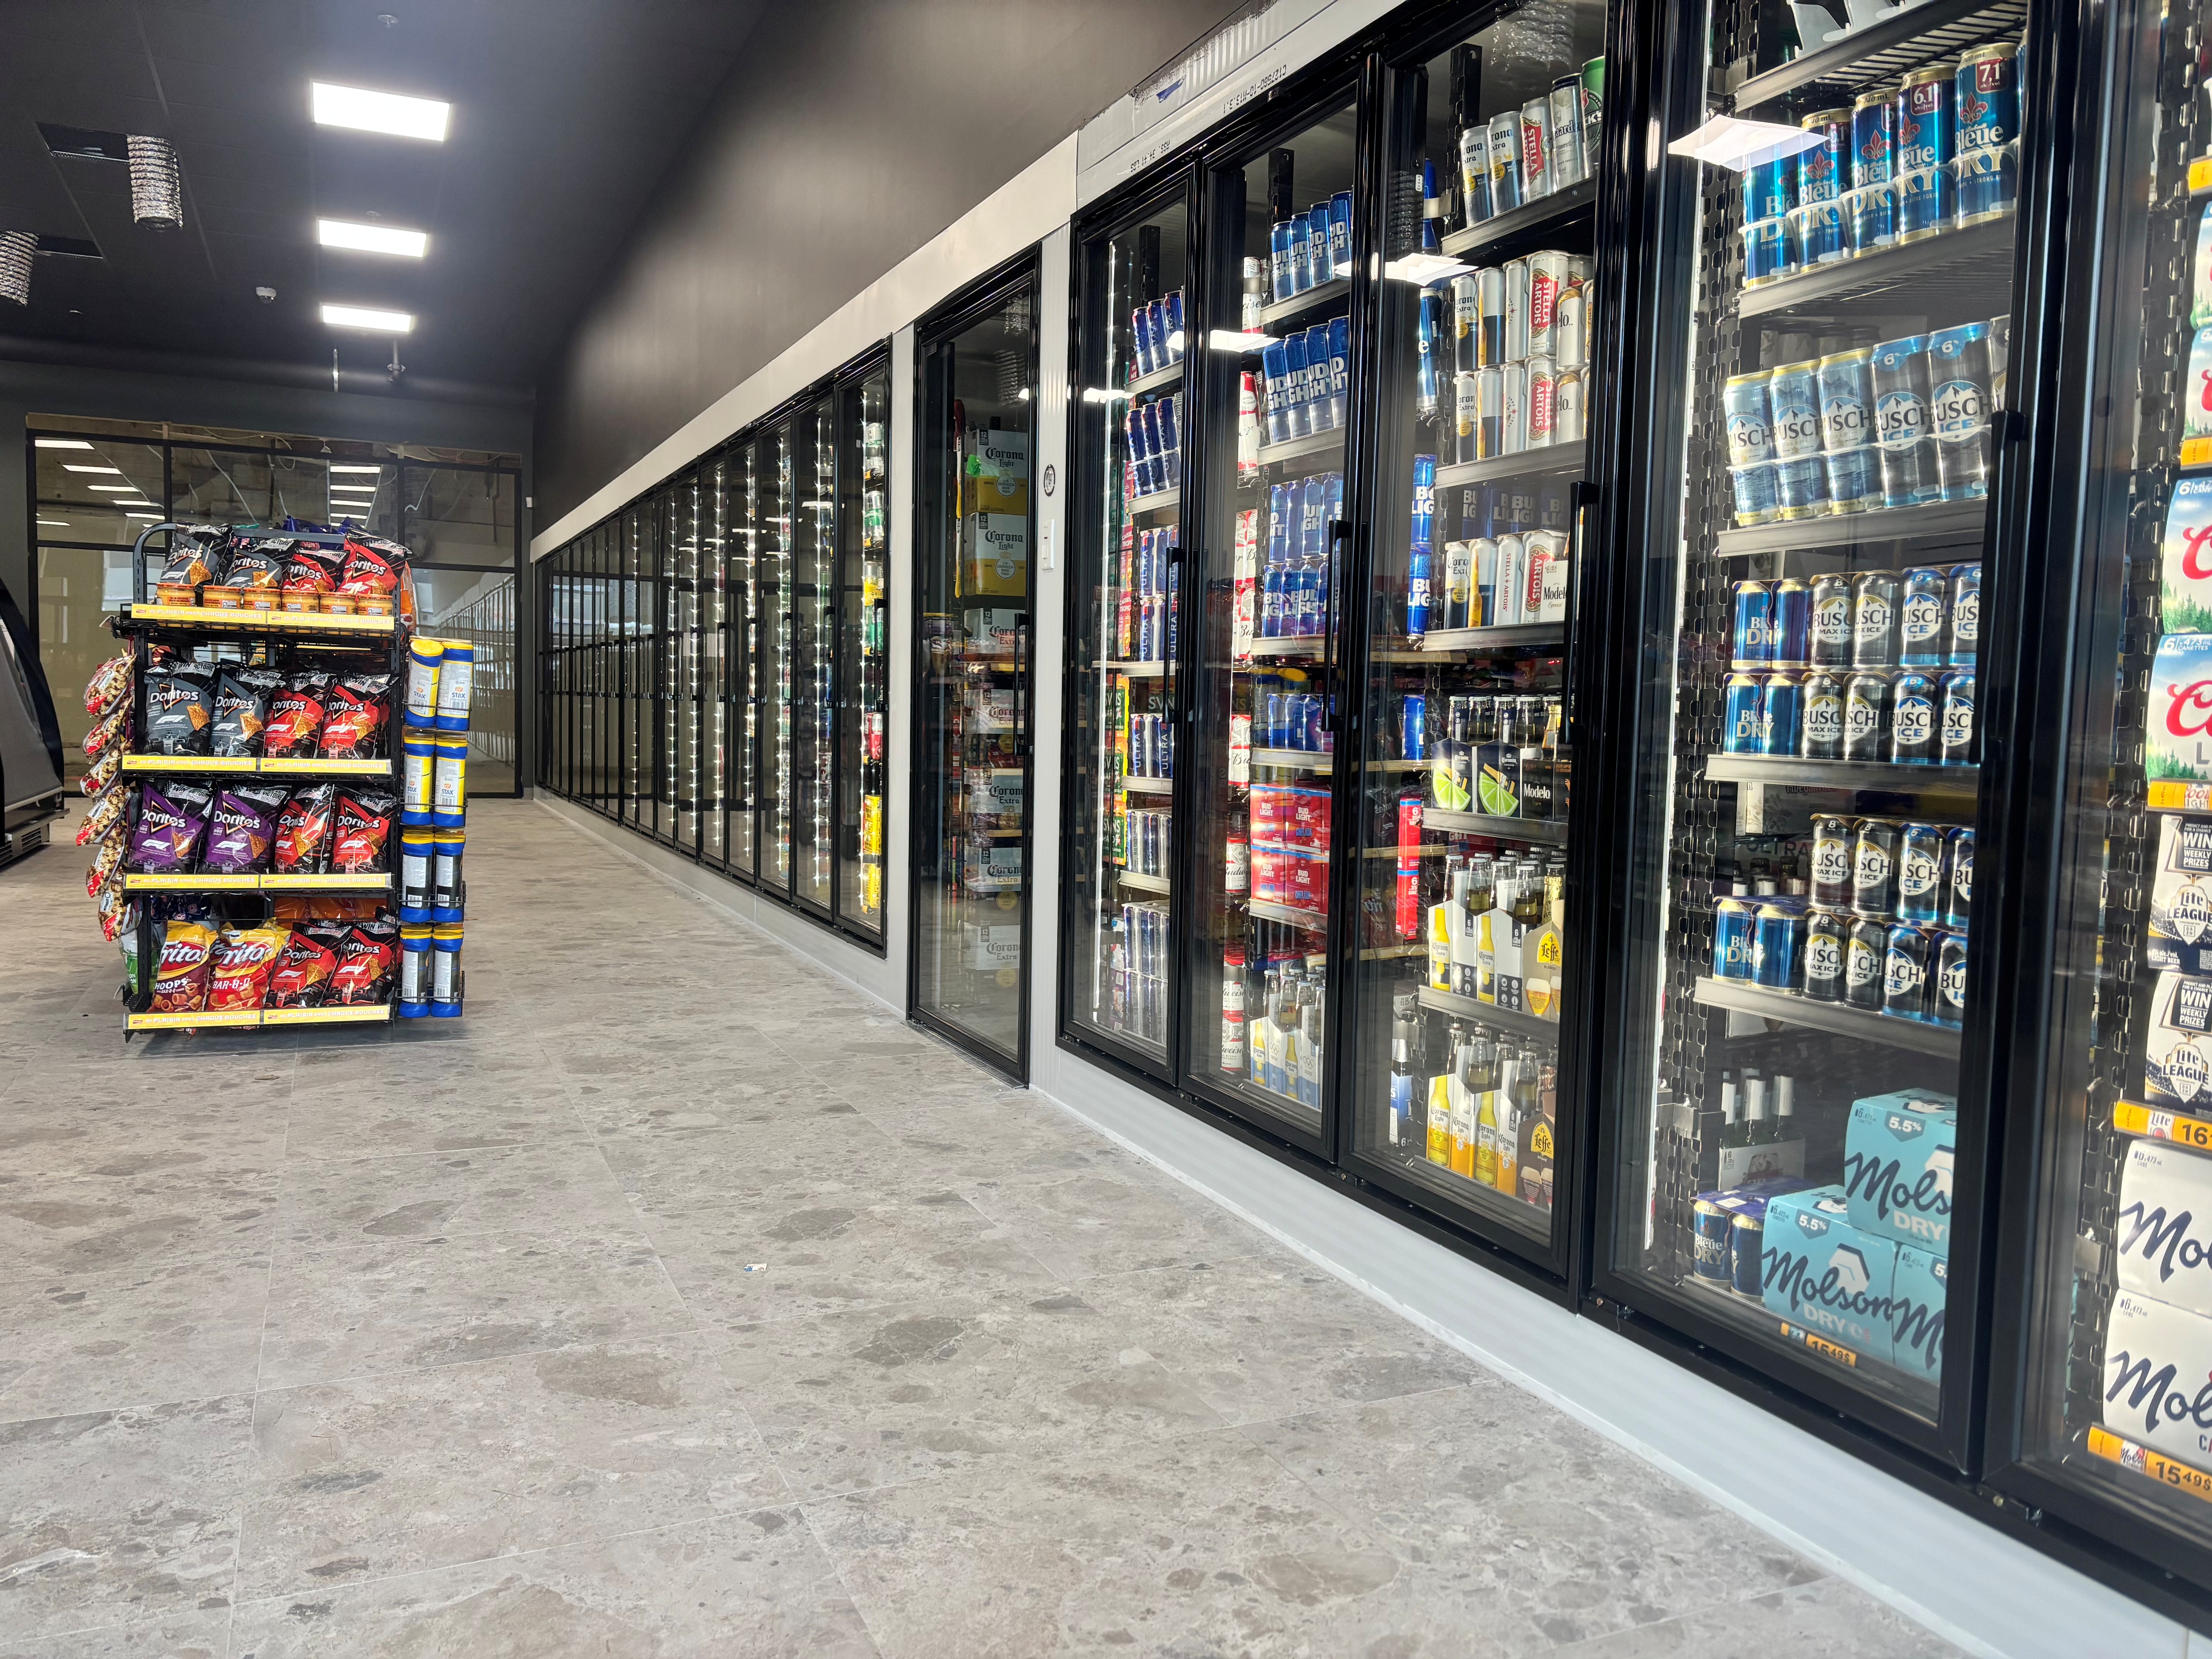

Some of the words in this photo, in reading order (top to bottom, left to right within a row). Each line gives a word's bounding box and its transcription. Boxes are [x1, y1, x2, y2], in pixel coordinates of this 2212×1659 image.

[1528, 128, 1537, 172] STELLA
[1932, 395, 1990, 423] USCH
[1823, 408, 1873, 434] USCH
[1940, 418, 1974, 433] ICE
[1729, 426, 1772, 450] USCH
[1884, 428, 1915, 442] ICE
[986, 447, 1025, 461] Corona
[999, 459, 1014, 467] Light
[985, 531, 1023, 544] Corona
[998, 542, 1013, 550] Light
[1533, 558, 1543, 599] ARTOIS
[1544, 586, 1566, 600] Model
[1856, 609, 1895, 626] USCH
[150, 689, 199, 703] Doritos
[215, 696, 254, 709] Doritos
[273, 700, 306, 711] oritos
[1898, 728, 1924, 737] ICE
[989, 785, 1023, 799] Coron
[1524, 783, 1551, 799] Modelo
[214, 811, 260, 829] Doritos
[1296, 814, 1311, 822] LIGHT
[2183, 832, 2212, 849] WIN
[2183, 857, 2209, 867] PRIZES
[2184, 850, 2211, 859] WEEKLY
[987, 864, 1022, 877] Coron
[1296, 875, 1310, 884] LIGHT
[2180, 891, 2203, 907] Lite
[347, 942, 381, 953] oritos
[986, 942, 1020, 955] Coron
[1541, 943, 1559, 961] Leffe
[155, 977, 188, 990] HOOPS
[2181, 989, 2211, 1008] WIN
[2179, 1015, 2205, 1026] PRIZES
[2180, 1008, 2208, 1018] WEEKLY
[2176, 1050, 2199, 1066] Lite
[2162, 1064, 2209, 1085] LEAGUE
[1431, 1106, 1449, 1118] Corona
[2151, 1111, 2170, 1126] Lite
[1453, 1116, 1469, 1131] Corona
[1477, 1123, 1496, 1136] Corona
[1889, 1116, 1922, 1132] 5.5%
[1499, 1133, 1515, 1149] Corona
[1535, 1134, 1551, 1153] Leffe
[1845, 1152, 1952, 1221] Mols
[1799, 1214, 1826, 1230] 5.5%
[1894, 1210, 1944, 1240] DRY
[1695, 1233, 1723, 1250] Bleue
[1694, 1245, 1725, 1265] DRY
[1762, 1247, 1893, 1321] Molson
[1803, 1303, 1844, 1333] DRY
